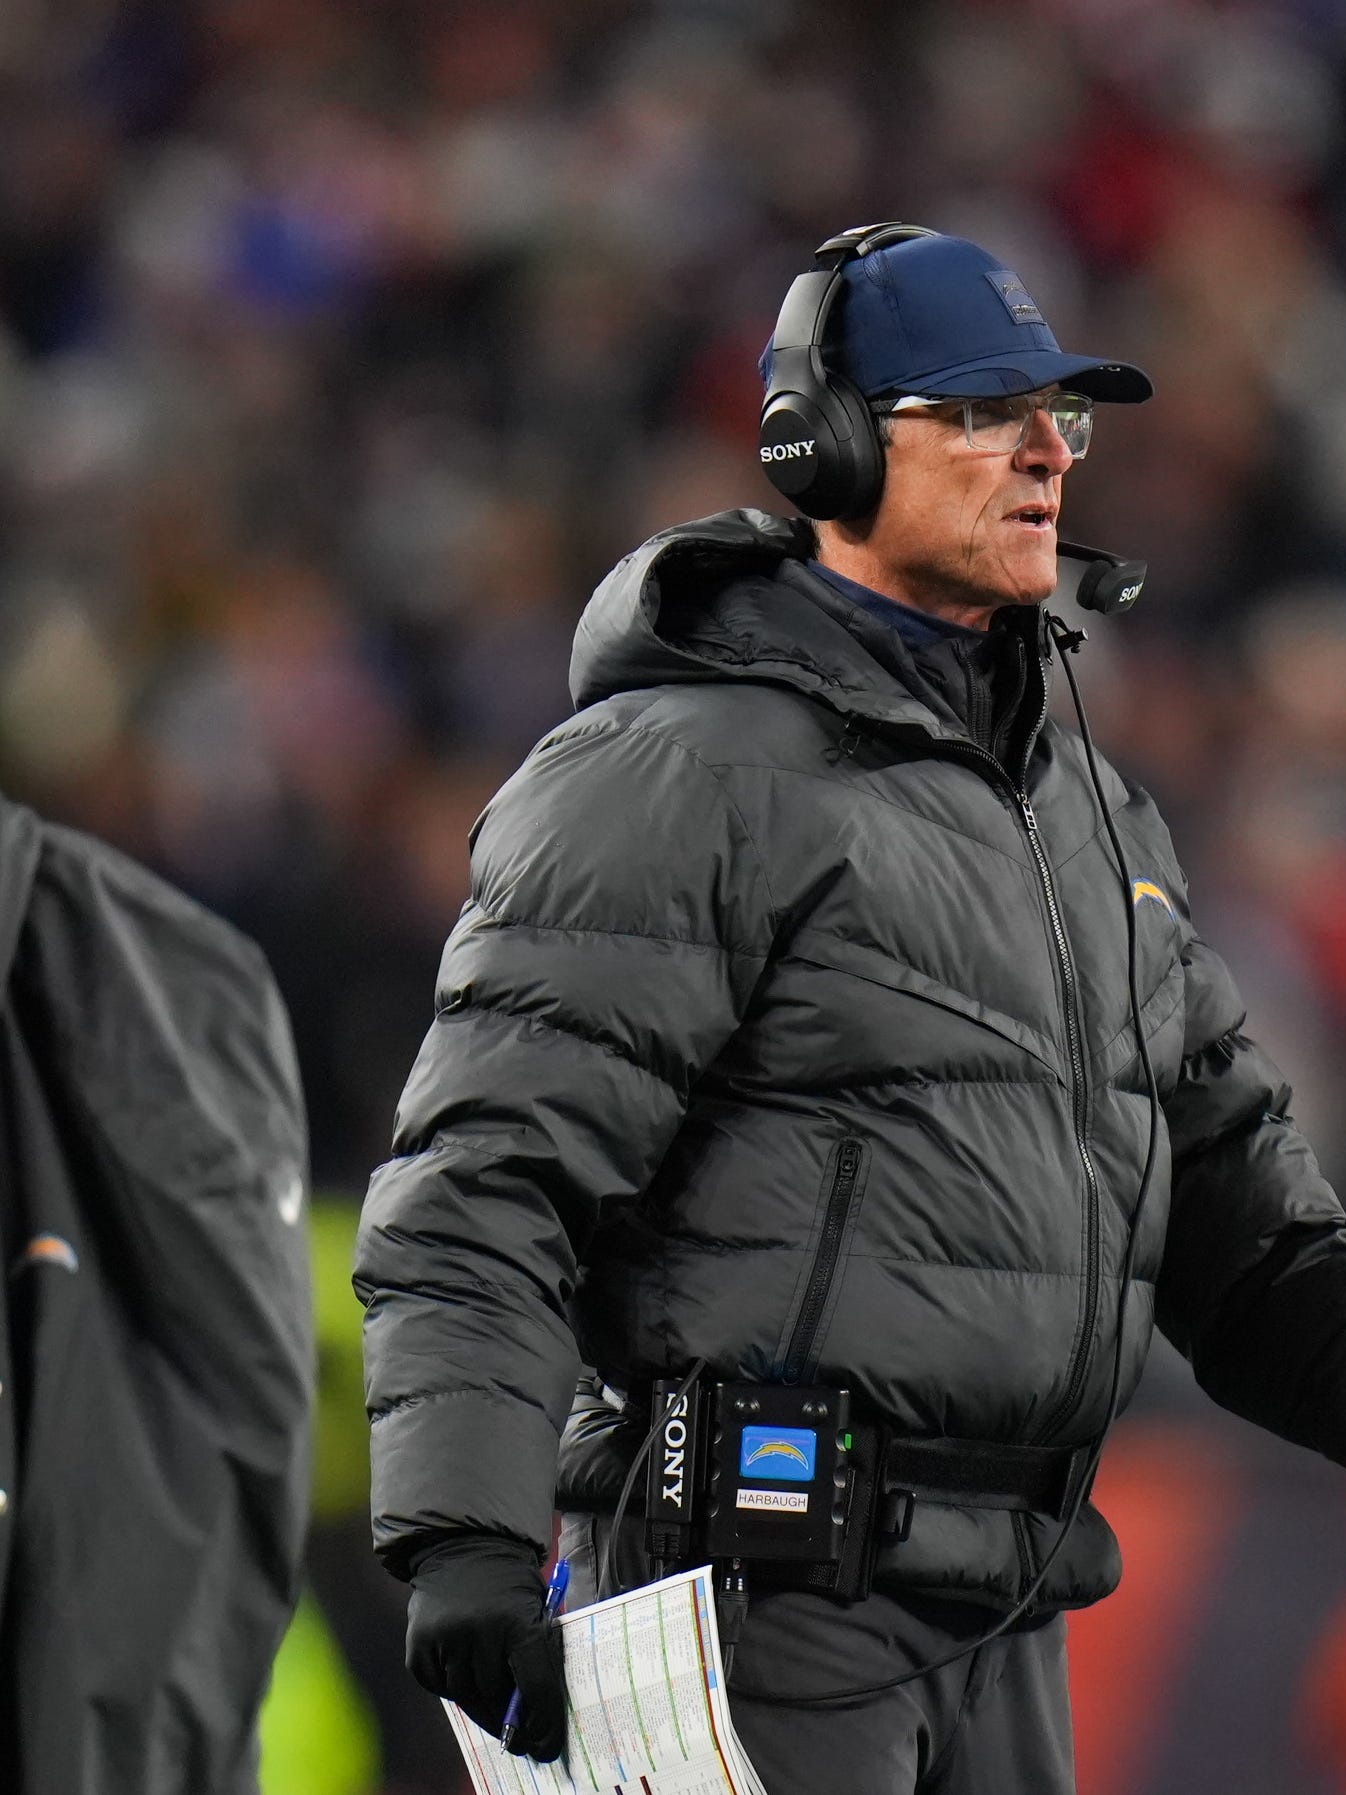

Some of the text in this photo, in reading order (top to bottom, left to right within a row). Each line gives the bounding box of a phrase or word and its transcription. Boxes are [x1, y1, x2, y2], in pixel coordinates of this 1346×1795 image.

[760, 440, 815, 462] SONY
[662, 1392, 688, 1508] SONY
[738, 1493, 806, 1508] HARBAUGH
